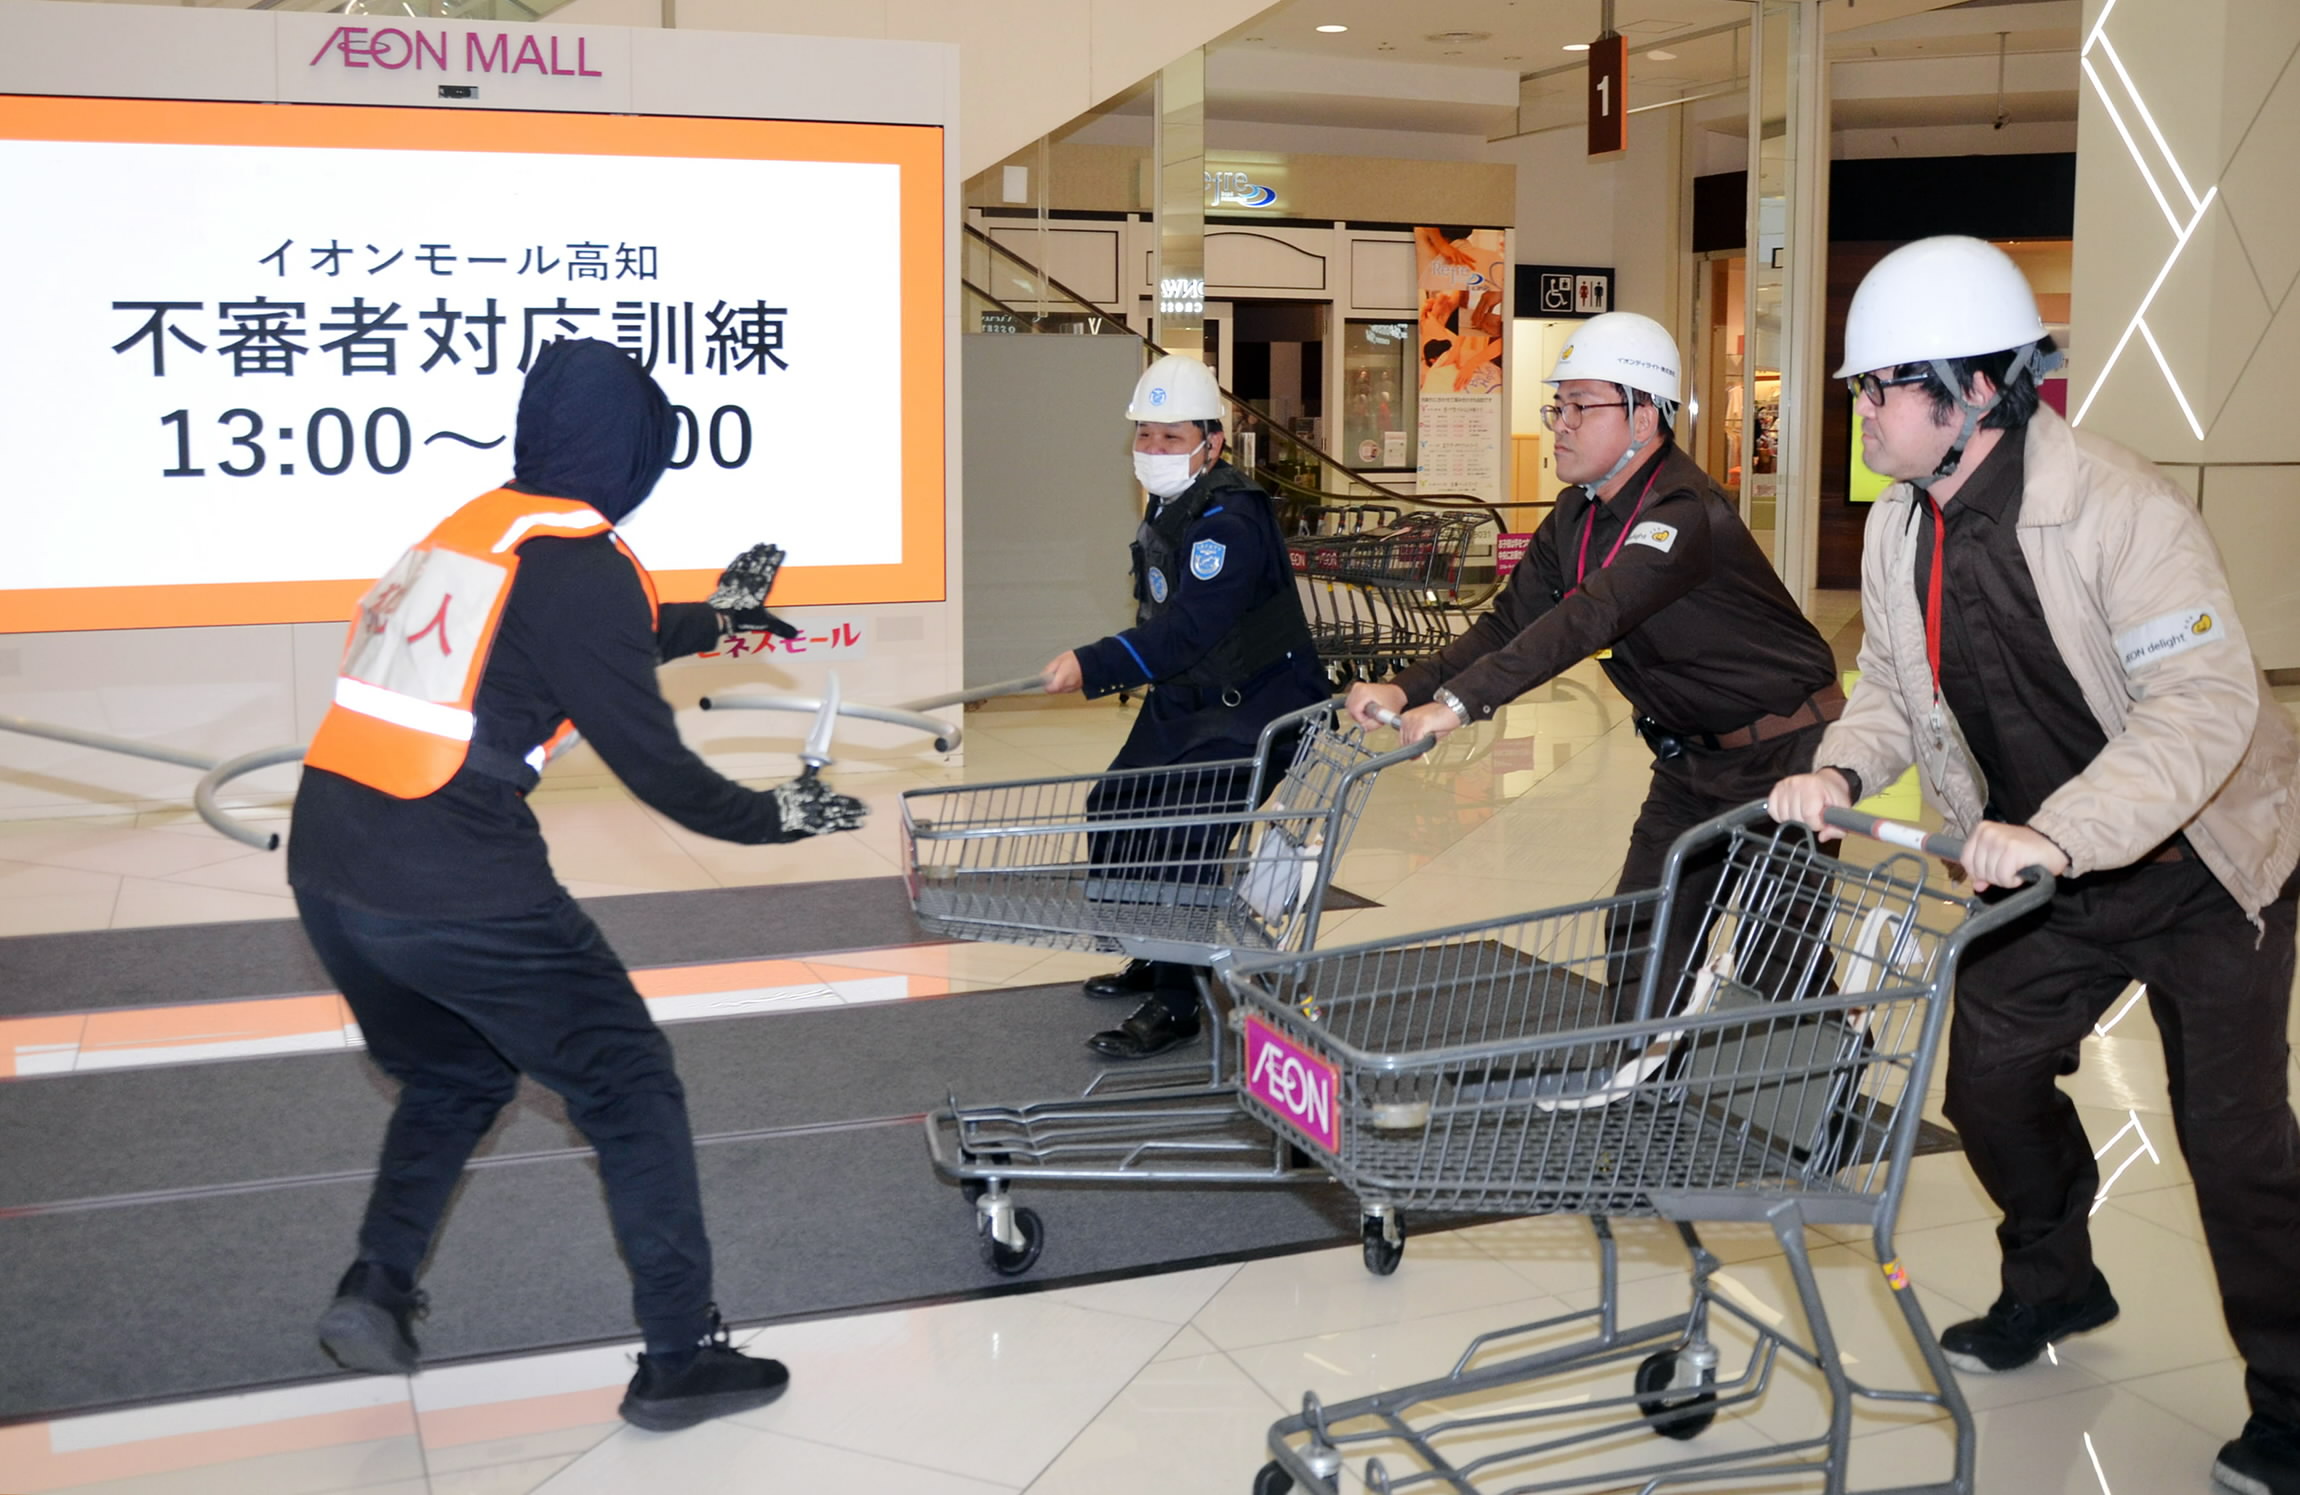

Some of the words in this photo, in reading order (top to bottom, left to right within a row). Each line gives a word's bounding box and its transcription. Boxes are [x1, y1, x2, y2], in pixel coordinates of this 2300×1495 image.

[466, 32, 603, 77] MALL
[1596, 75, 1609, 117] 1
[258, 239, 659, 281] イオンモール高知
[2147, 632, 2187, 654] delight
